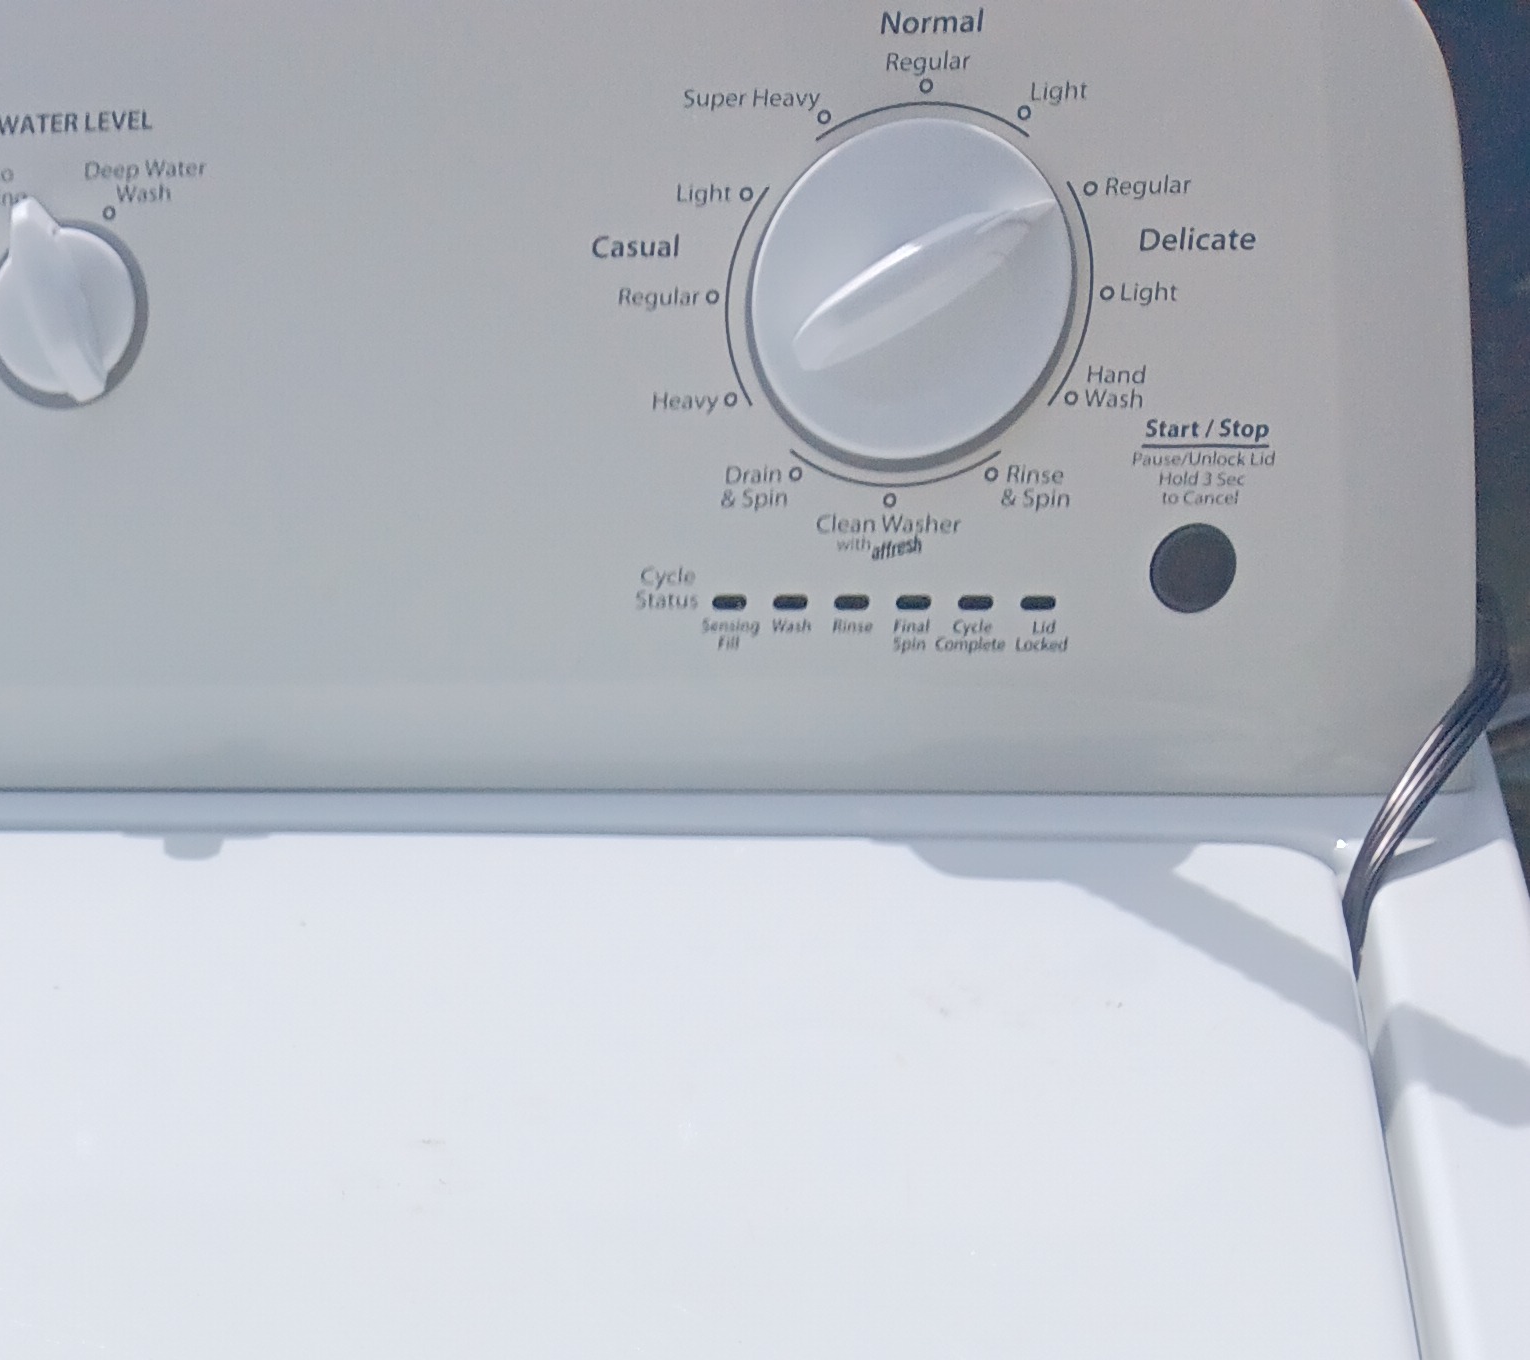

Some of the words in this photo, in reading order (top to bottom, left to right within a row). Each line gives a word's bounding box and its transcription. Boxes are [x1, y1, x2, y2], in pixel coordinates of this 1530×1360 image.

[880, 8, 984, 35] Normal
[886, 50, 971, 76] Regular
[683, 89, 747, 112] Super
[752, 88, 821, 112] Heavy
[1030, 81, 1088, 106] Light
[84, 109, 153, 132] LEVEL
[84, 160, 140, 183] Deep
[144, 157, 207, 178] Water
[116, 184, 172, 204] Wash
[676, 183, 731, 207] Light
[1104, 174, 1192, 199] Regular
[591, 233, 680, 259] Casual
[1139, 226, 1257, 252] Delicate
[619, 286, 700, 311] Regular
[1120, 281, 1179, 307] Light
[1086, 364, 1147, 385] Hand
[652, 390, 719, 415] Heavy
[1085, 387, 1144, 409] Wash
[1145, 418, 1199, 439] Start
[1205, 418, 1215, 439] /
[1219, 417, 1270, 444] Stop
[1131, 450, 1245, 468] Pause/Unlock
[1249, 450, 1276, 467] Lid
[725, 464, 782, 485] Drain
[1006, 464, 1064, 485] Rinse
[1159, 471, 1200, 489] Hold
[1202, 471, 1214, 488] 3
[1218, 471, 1245, 487] Sec
[720, 488, 737, 508] &
[741, 486, 788, 511] Spin
[1000, 488, 1017, 508] &
[1022, 487, 1070, 512] Spin
[1162, 492, 1179, 506] to
[1183, 491, 1239, 506] Cancel
[816, 513, 876, 534] Clean
[881, 513, 963, 534] Washer
[836, 535, 871, 552] with
[640, 566, 696, 589] Cycle
[635, 590, 699, 610] Status
[701, 617, 761, 637] Sensing
[772, 617, 812, 633] Wash
[832, 618, 874, 633] Rinse
[892, 618, 931, 633] Final
[953, 618, 993, 637] Cycle
[1032, 619, 1057, 635] Lid
[893, 636, 927, 654] Spin
[935, 636, 1006, 654] Complete
[1015, 637, 1068, 651] Locked
